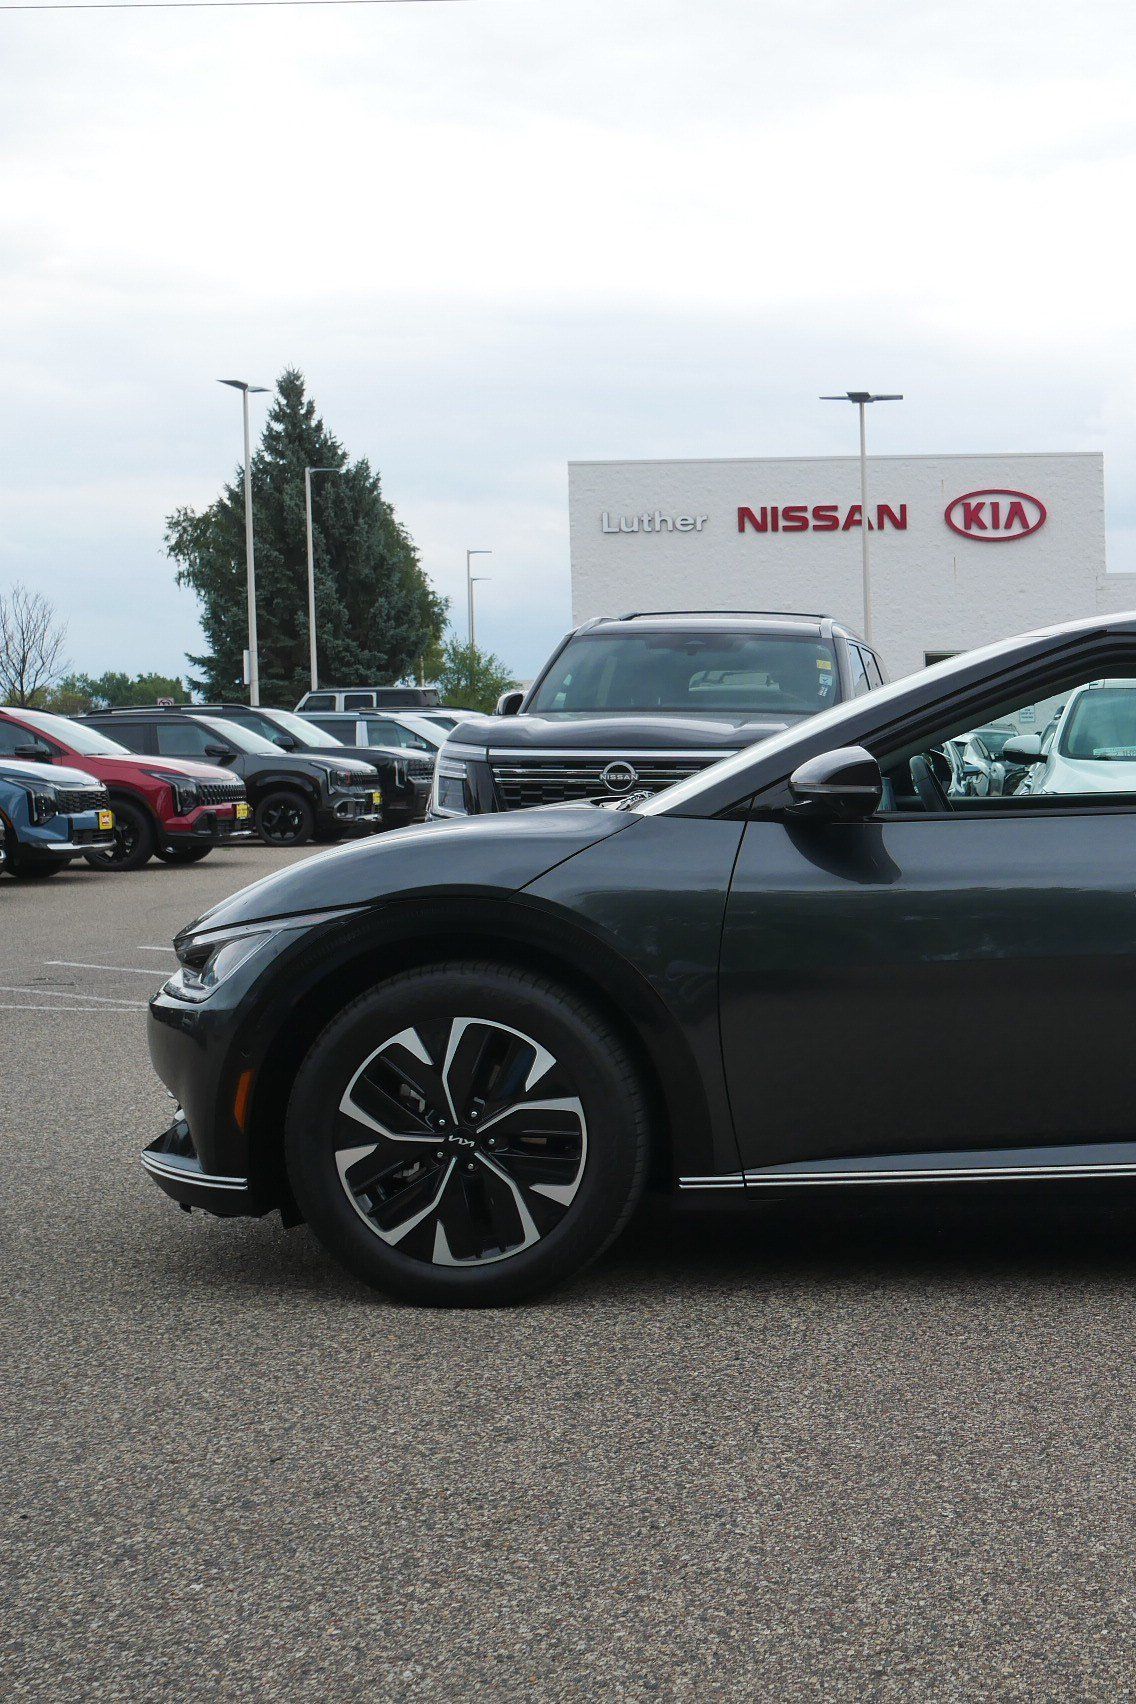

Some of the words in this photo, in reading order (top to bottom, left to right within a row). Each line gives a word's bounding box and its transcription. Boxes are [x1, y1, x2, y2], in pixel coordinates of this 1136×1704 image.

[602, 510, 708, 533] Luther
[738, 503, 907, 533] NISSAN
[961, 501, 1030, 530] KIA
[599, 773, 639, 781] NISSAN
